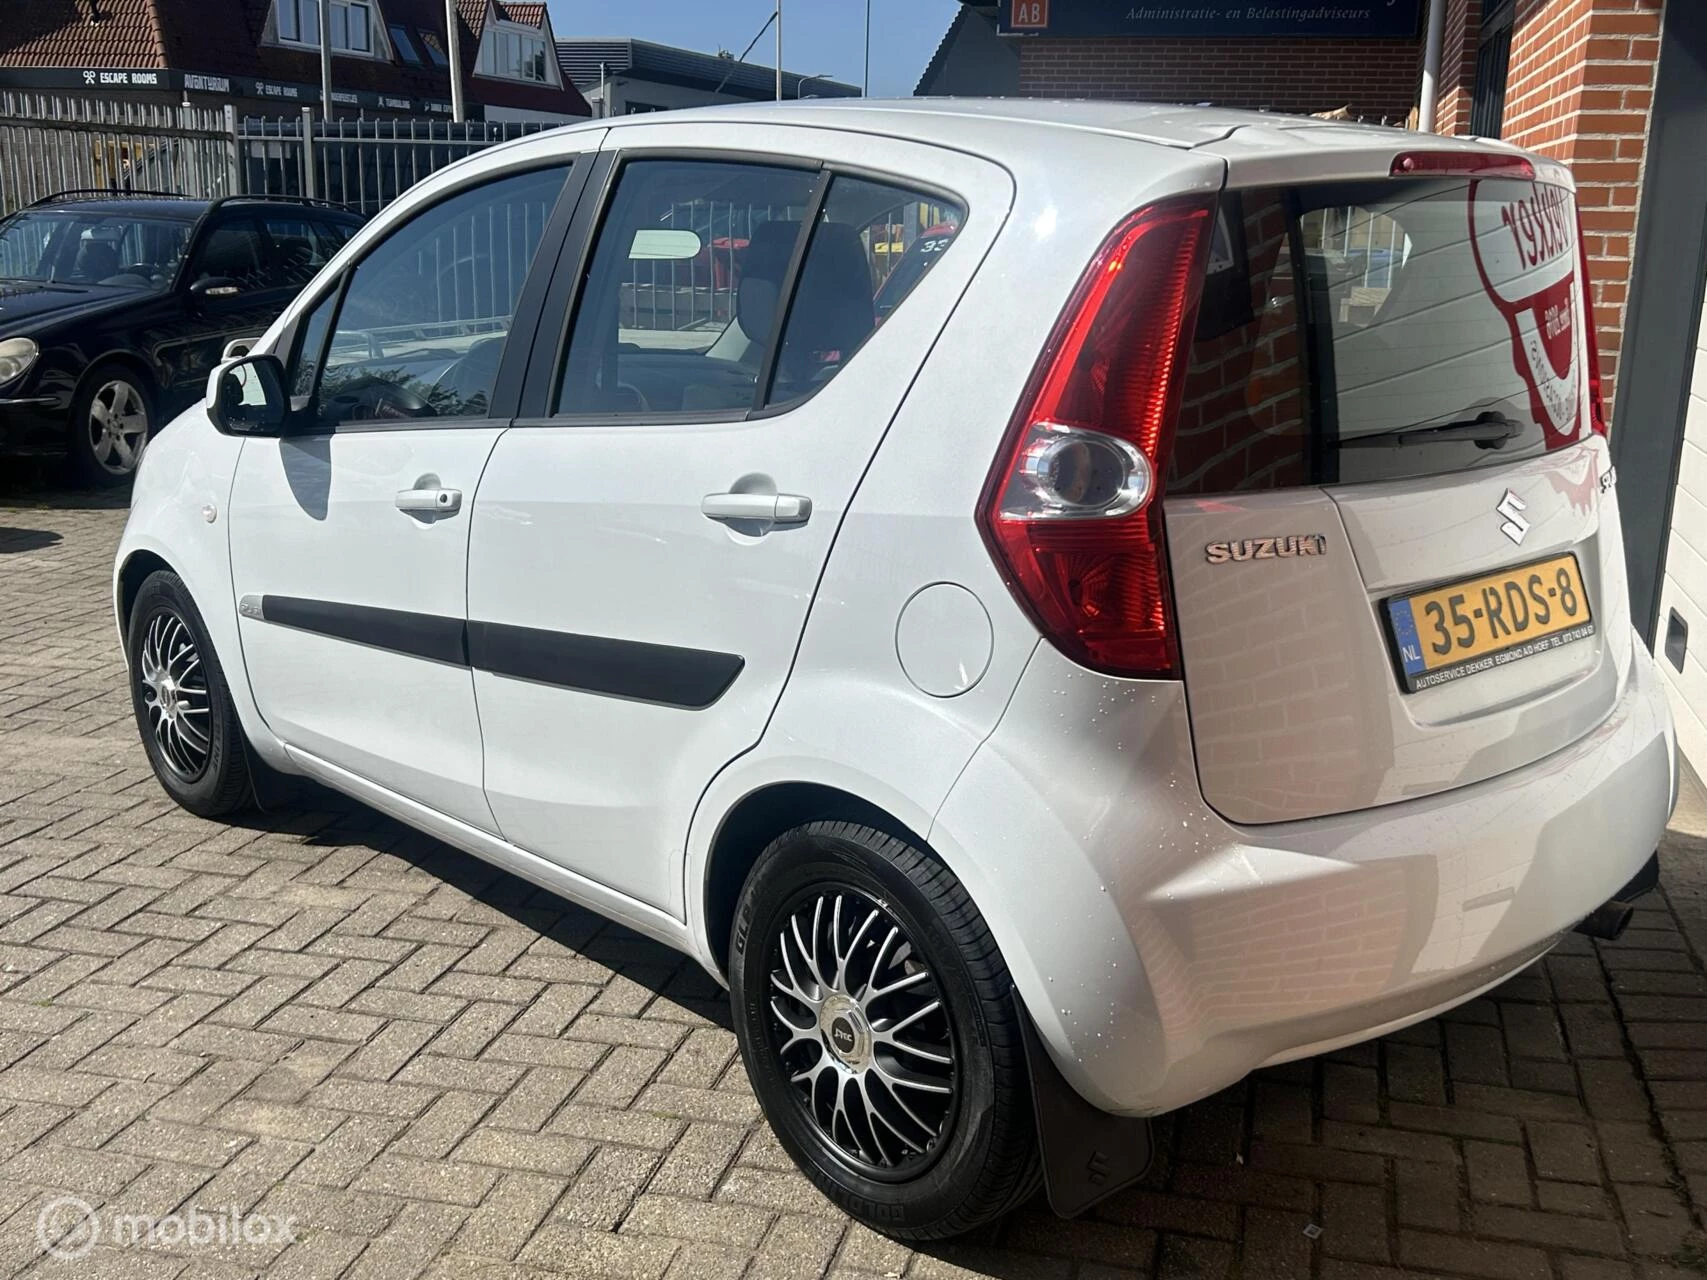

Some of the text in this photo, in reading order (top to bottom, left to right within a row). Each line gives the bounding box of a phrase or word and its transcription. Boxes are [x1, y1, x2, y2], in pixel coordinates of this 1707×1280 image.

[1126, 7, 1370, 21] Administratie- en Belastingadviseurs
[100, 73, 157, 84] ESCAPE ROOMS
[1205, 533, 1327, 564] SUZUKI
[1424, 567, 1577, 656] 35-RDS-8
[1402, 644, 1421, 663] NL
[1416, 667, 1465, 689] AUTOSERVICE
[1466, 657, 1494, 675] DEKKER
[1495, 649, 1522, 664] EGMOND
